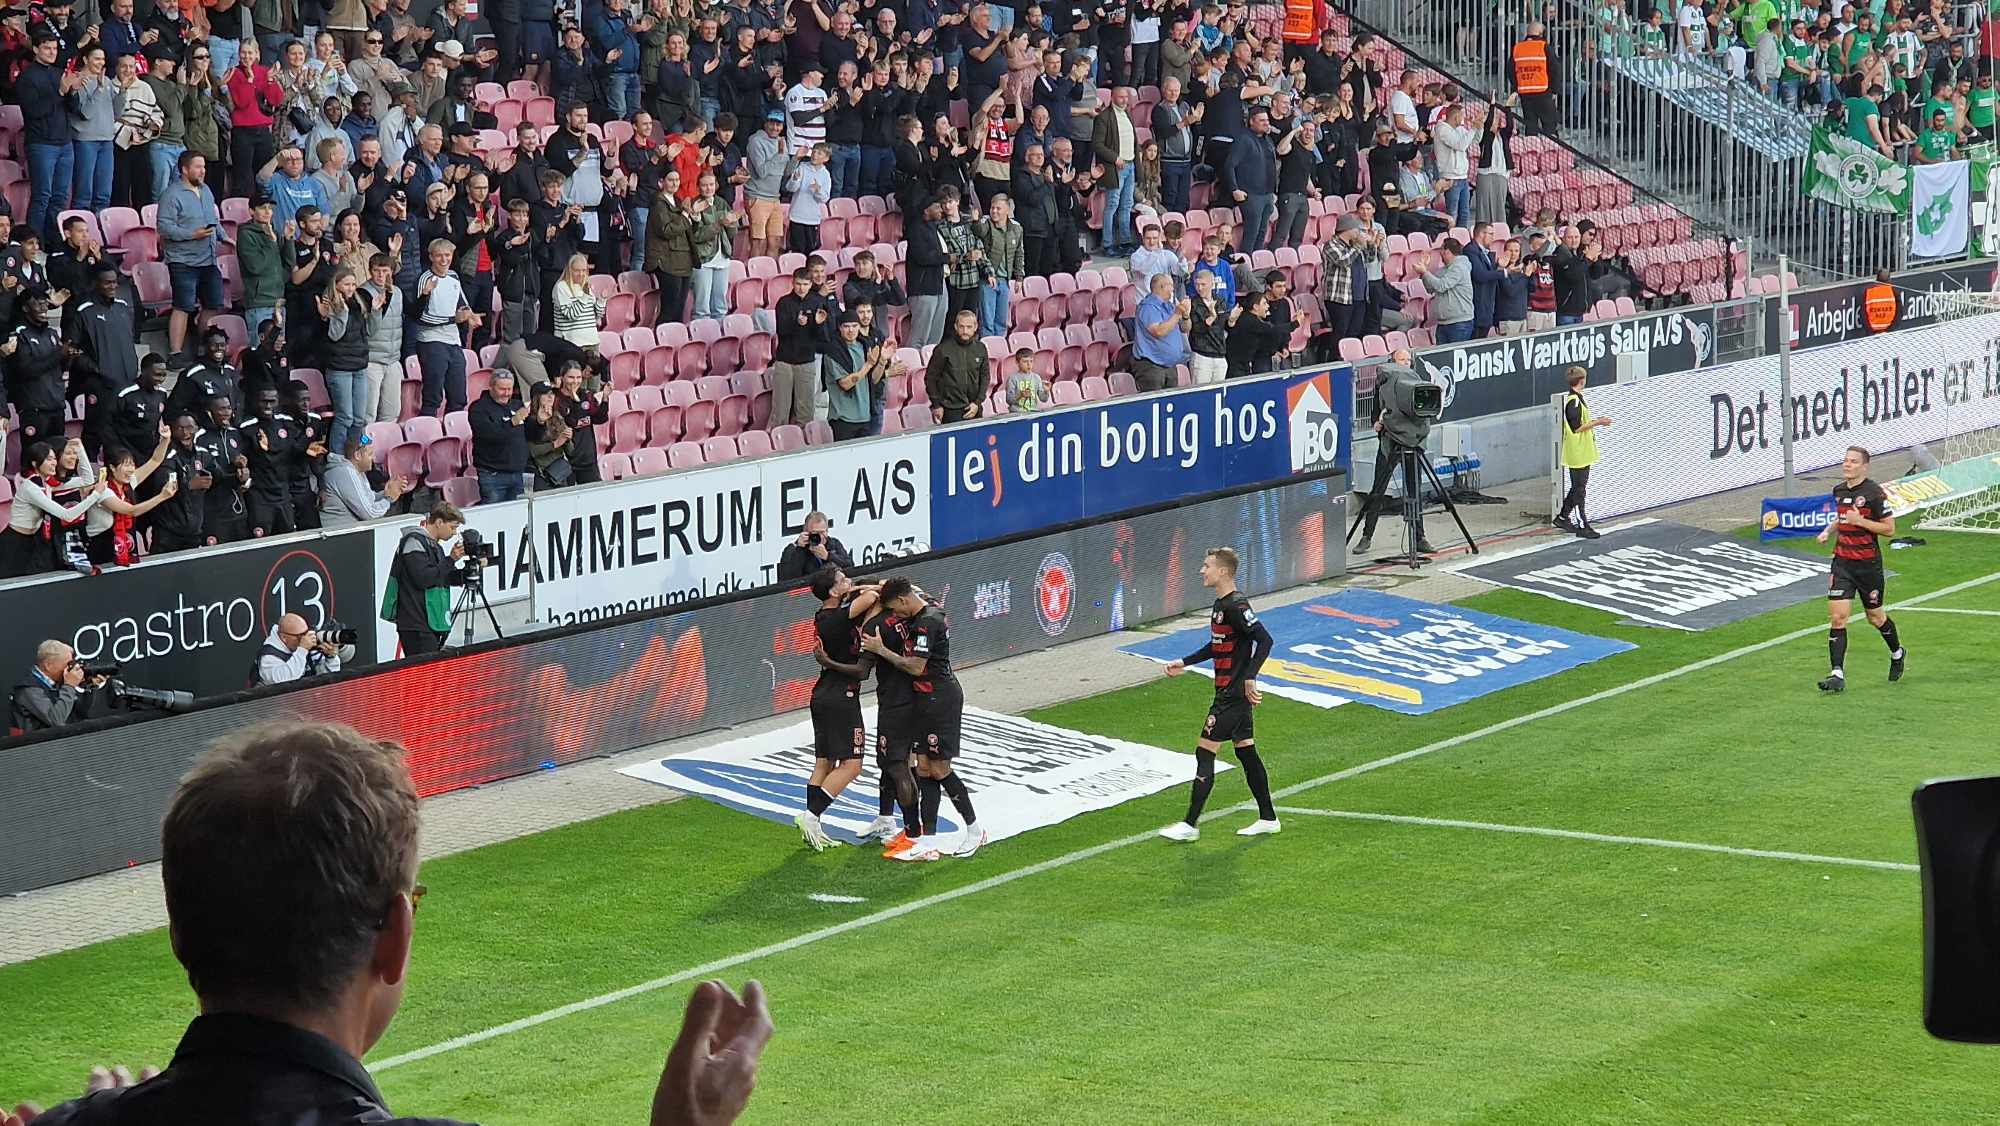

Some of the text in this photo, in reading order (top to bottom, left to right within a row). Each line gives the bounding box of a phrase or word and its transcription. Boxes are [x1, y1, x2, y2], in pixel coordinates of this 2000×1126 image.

[1453, 313, 1684, 382] Dansk Værktøjs Salg A/S
[1806, 296, 1863, 341] Arbejde
[1304, 417, 1338, 465] BO
[1710, 388, 1770, 460] Det
[1780, 368, 1850, 444] med
[1861, 357, 1935, 427] biler
[948, 394, 1277, 507] lej din bolig hos
[479, 485, 764, 592] HAMMERUM
[847, 458, 917, 525] A/S
[1781, 510, 1837, 528] Oddse
[272, 571, 325, 634] 13
